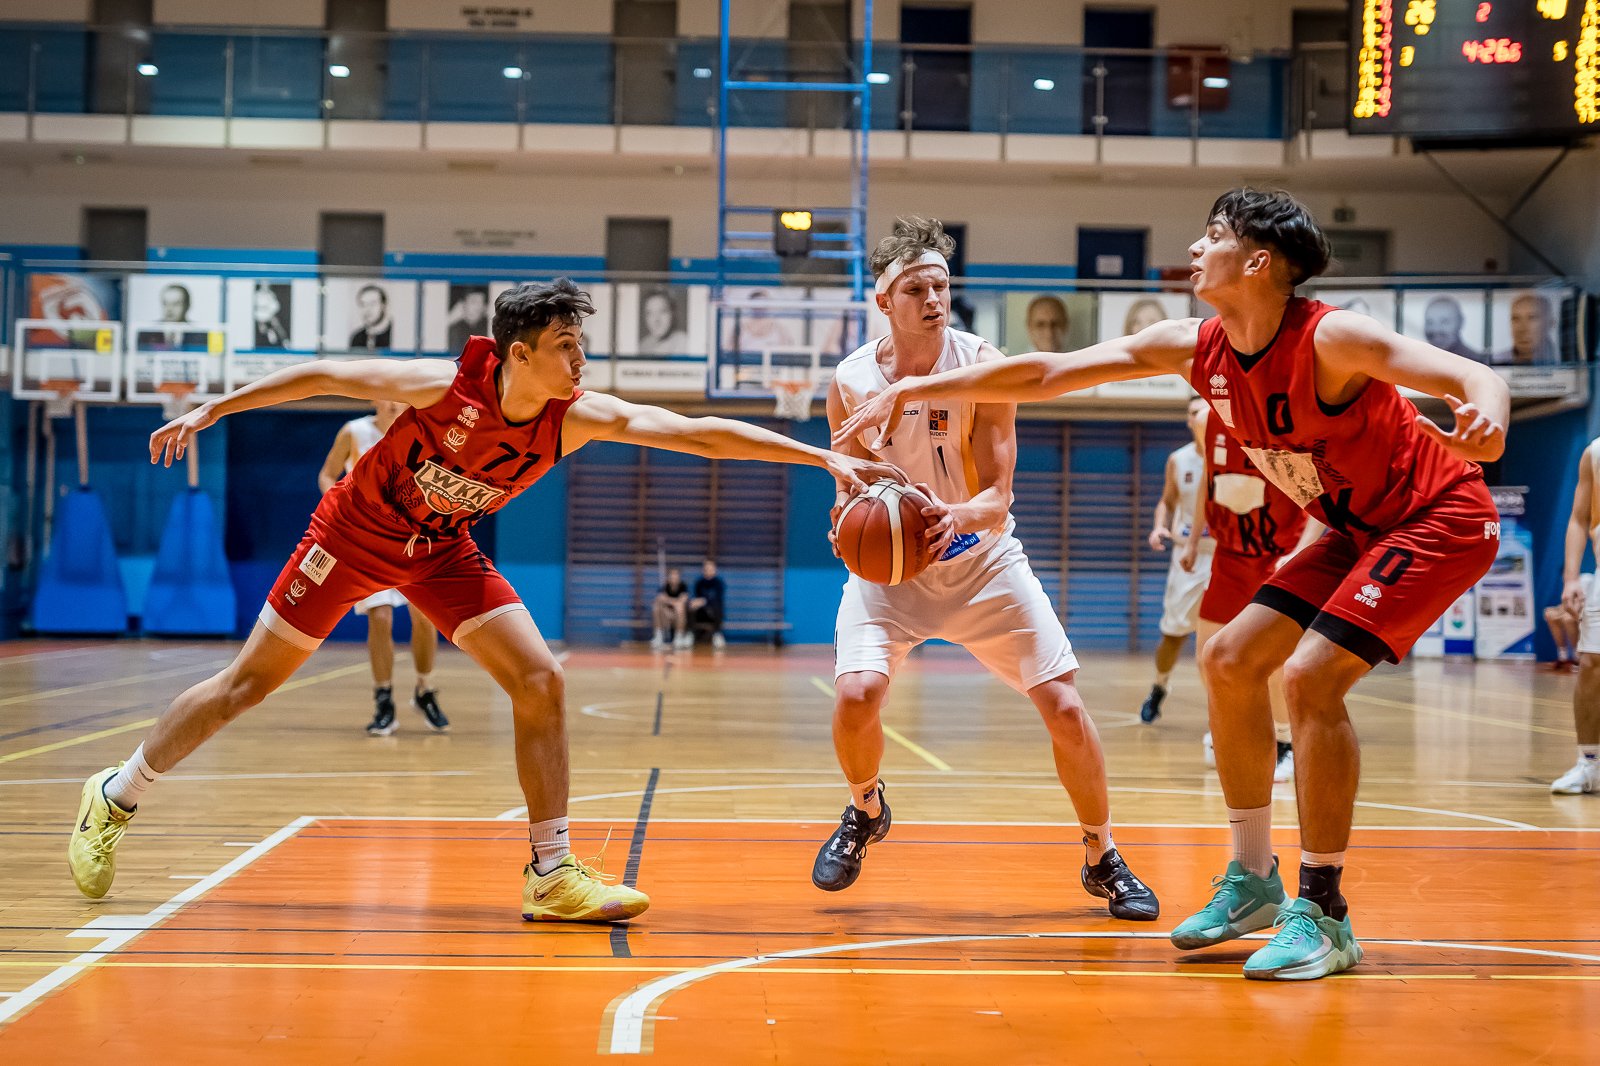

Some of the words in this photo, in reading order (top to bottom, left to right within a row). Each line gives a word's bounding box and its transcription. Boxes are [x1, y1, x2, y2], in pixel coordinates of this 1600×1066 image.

[1476, 2, 1492, 22] 2
[432, 469, 490, 504] WKK
[1354, 592, 1378, 608] errea
